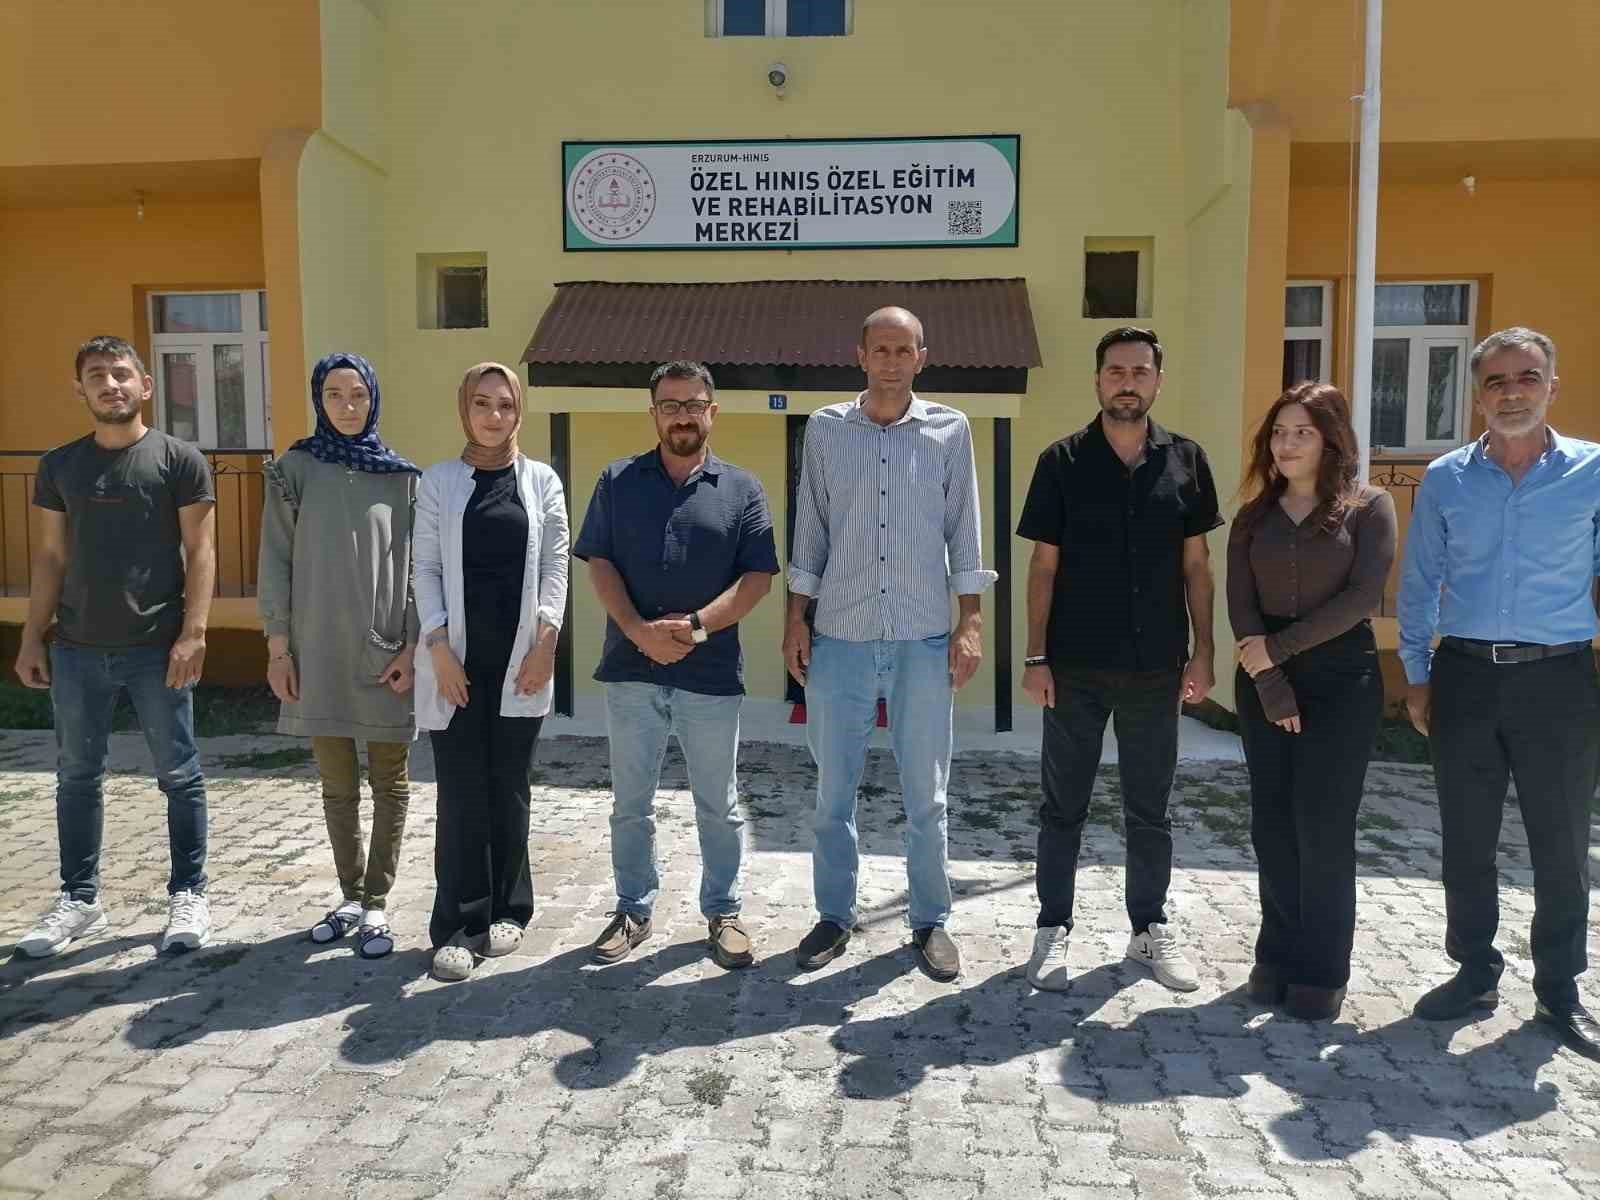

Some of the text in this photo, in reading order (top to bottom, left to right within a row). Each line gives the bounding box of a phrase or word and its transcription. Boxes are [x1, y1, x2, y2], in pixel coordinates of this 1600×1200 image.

[691, 153, 770, 163] ERZURUM-HINIS
[690, 163, 975, 191] ÖZEL HINIS ÖZEL EĞİTİM
[691, 192, 933, 217] VE REHABİLİTASYON
[695, 217, 799, 242] MERKEZİ
[773, 396, 784, 409] 15
